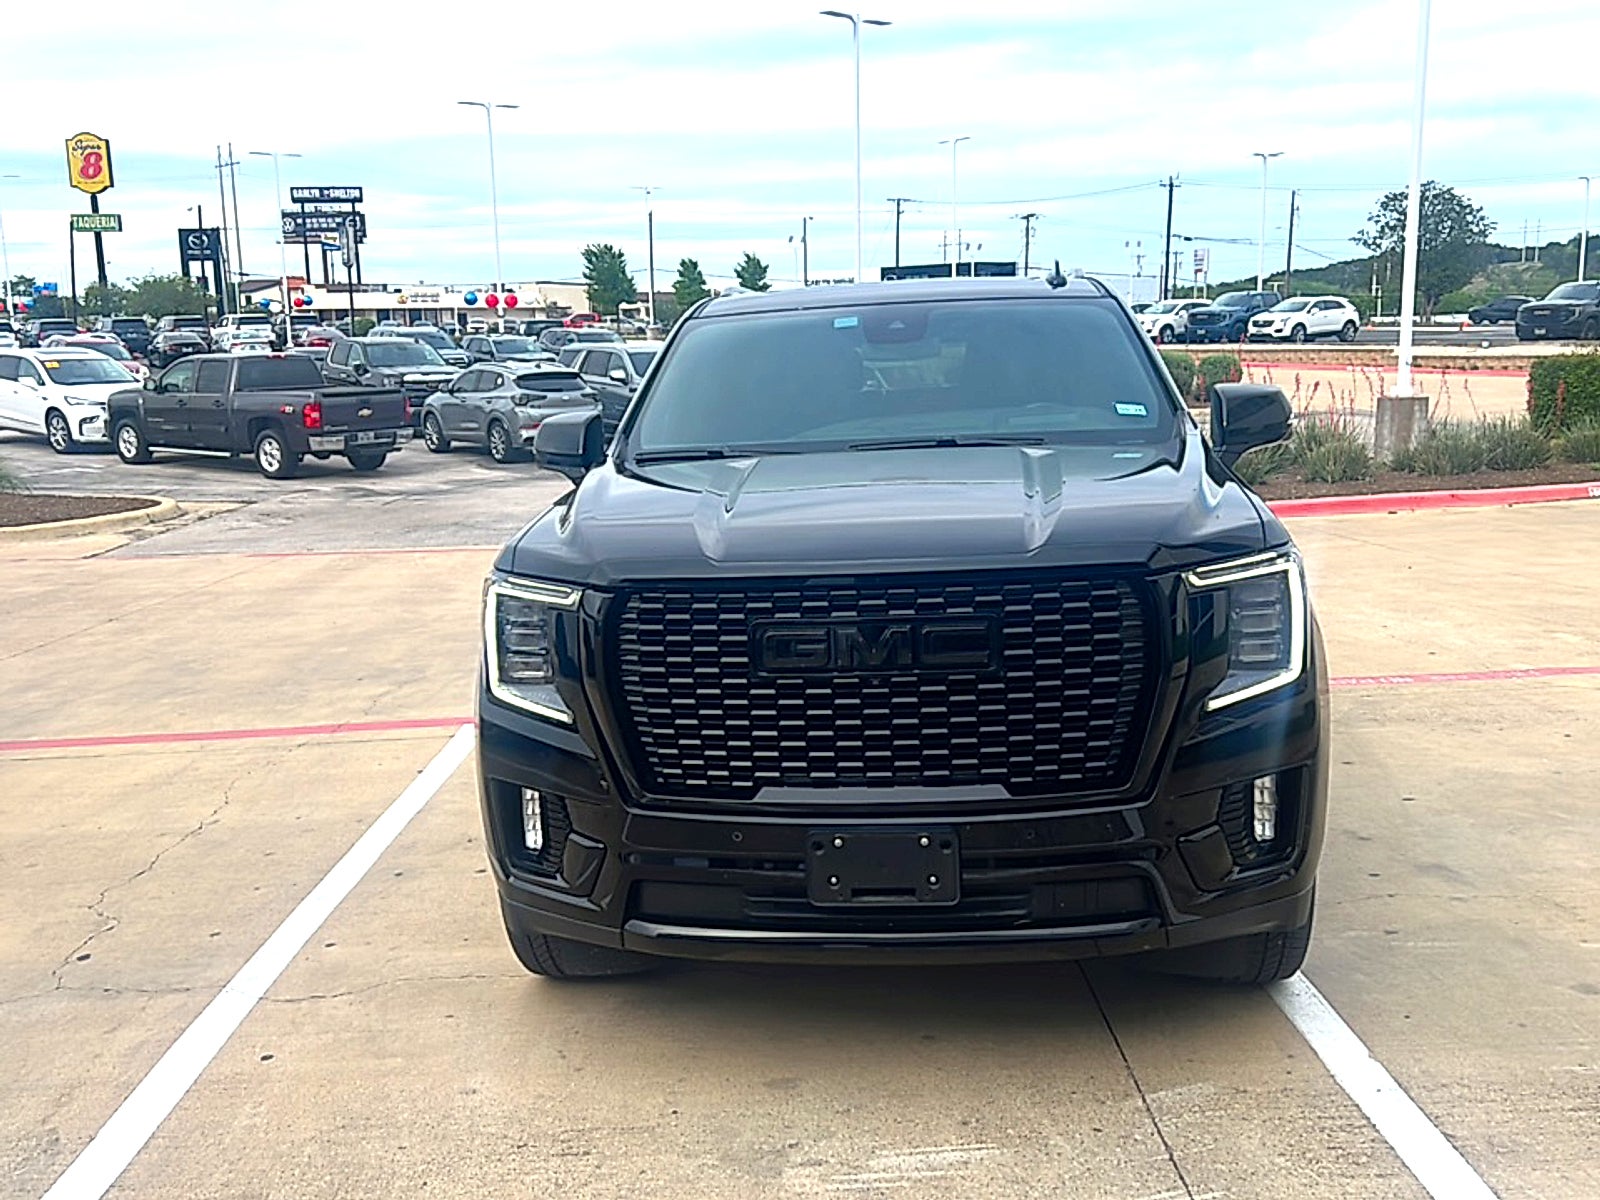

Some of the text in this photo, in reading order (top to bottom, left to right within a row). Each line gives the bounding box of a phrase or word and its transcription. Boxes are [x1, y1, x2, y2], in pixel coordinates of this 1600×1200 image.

[80, 152, 103, 179] 8
[72, 216, 116, 229] TAQUERIA
[761, 623, 990, 668] GMC
